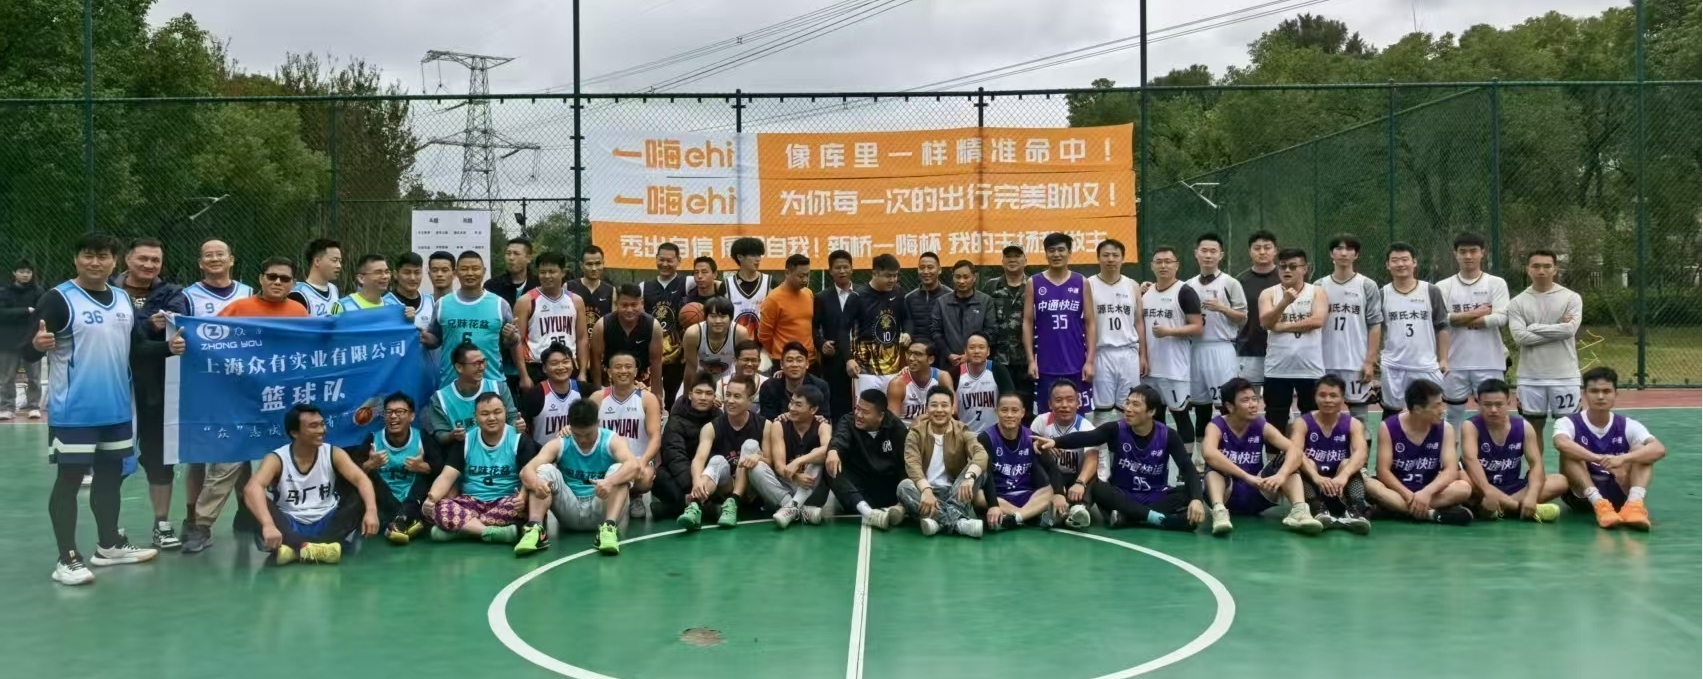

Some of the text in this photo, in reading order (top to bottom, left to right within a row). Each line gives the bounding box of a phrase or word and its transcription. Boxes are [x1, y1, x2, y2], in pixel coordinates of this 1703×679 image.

[785, 137, 1112, 169] 像库里一样精准命中！
[779, 181, 1116, 216] 为你每一次的出行完美助攻！
[619, 234, 714, 259] 秀出自信
[205, 302, 215, 314] 9
[315, 303, 328, 316] 22
[1038, 299, 1081, 312] 中通快运
[1097, 304, 1131, 316] 源氏木语
[82, 310, 104, 325] 36
[1051, 314, 1069, 330] 35
[1388, 310, 1429, 321] 源氏木语
[447, 319, 490, 330] 兄妹花盆
[539, 315, 573, 337] LVYUAN
[1109, 317, 1122, 331] 10
[1334, 317, 1347, 331] 17
[1405, 324, 1414, 337] 3
[882, 331, 891, 343] 10
[201, 339, 263, 351] ZHONG YOU
[199, 339, 406, 376] 上海众有实业有限公司
[260, 377, 346, 412] 篮球队
[1350, 380, 1363, 395] 17
[962, 391, 995, 410] LVYUAN
[1171, 389, 1178, 403] 1
[1555, 393, 1574, 409] 22
[975, 410, 982, 421] 7
[1118, 458, 1164, 475] 中通快运
[1392, 457, 1437, 472] 中通快运
[285, 480, 331, 506] 马厂村
